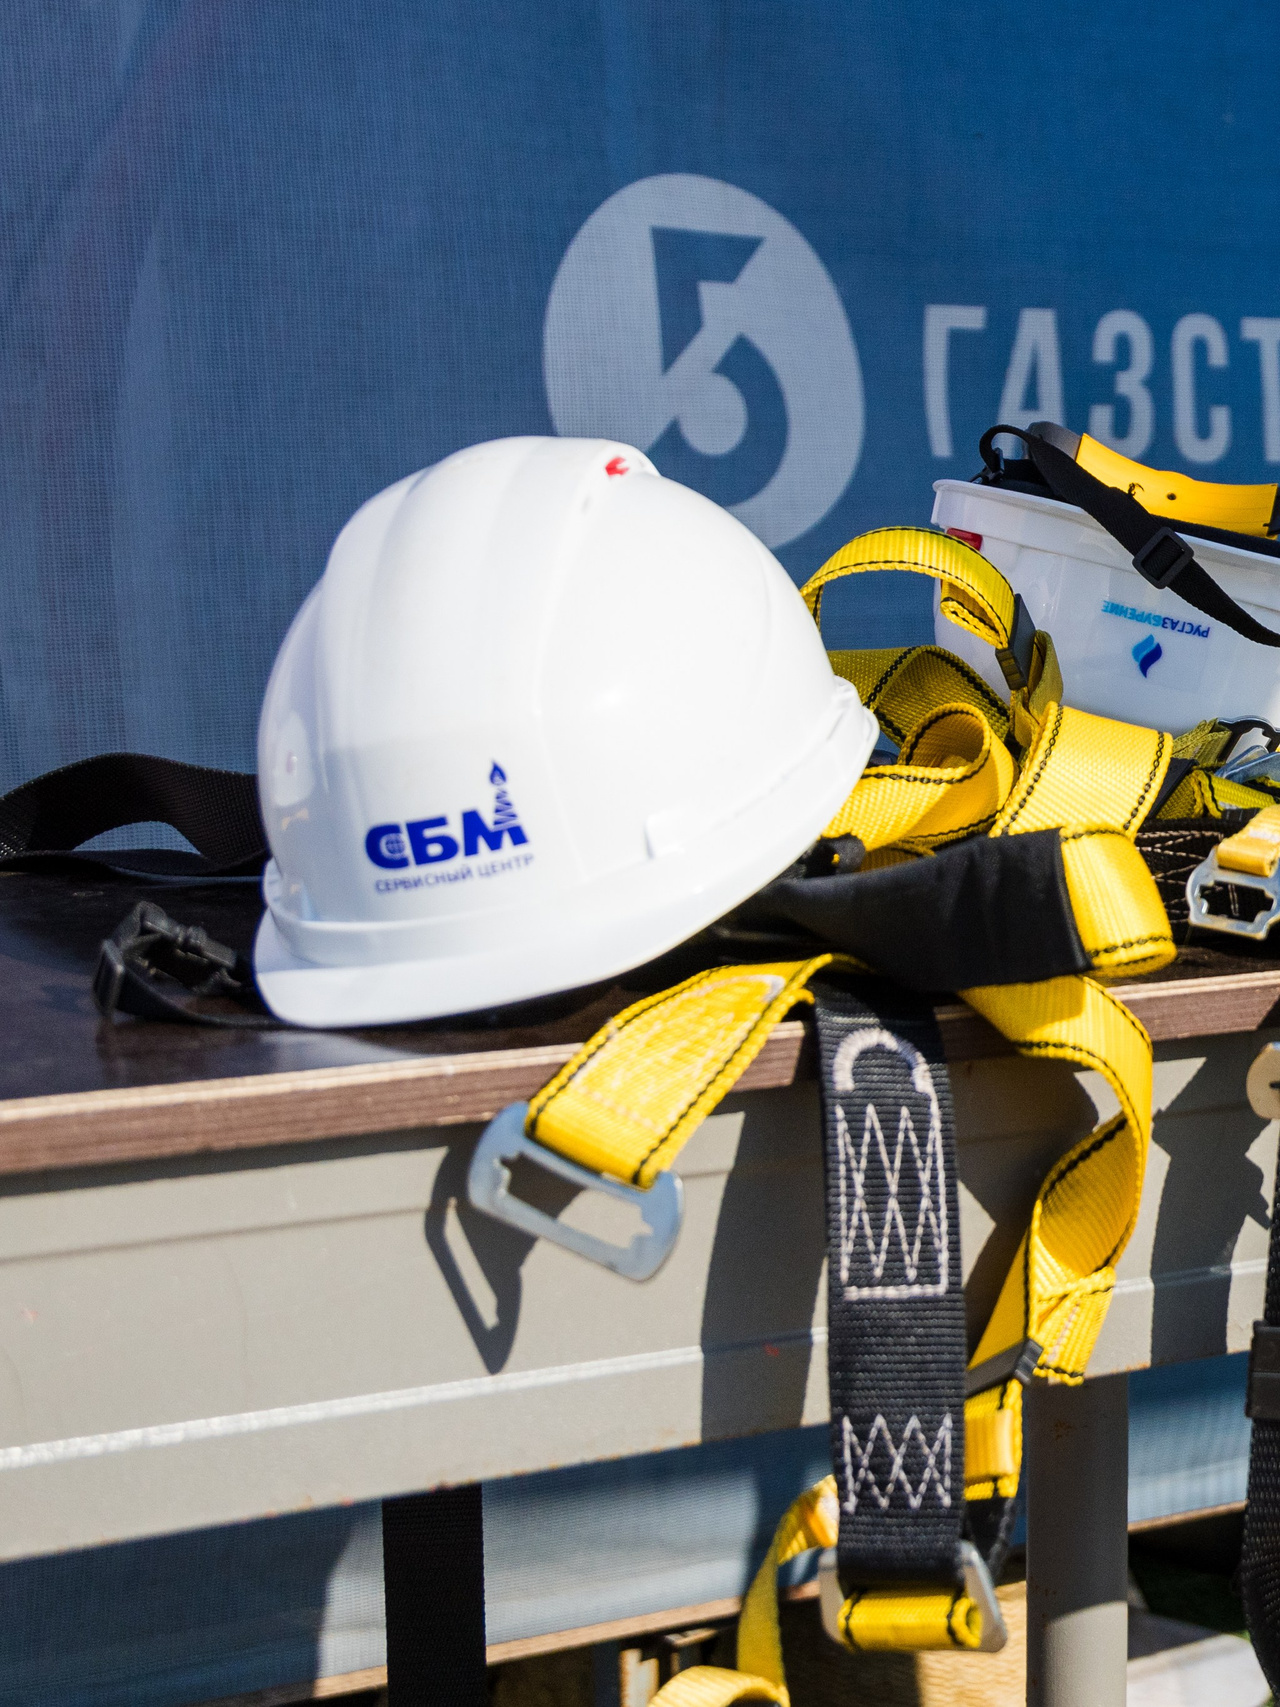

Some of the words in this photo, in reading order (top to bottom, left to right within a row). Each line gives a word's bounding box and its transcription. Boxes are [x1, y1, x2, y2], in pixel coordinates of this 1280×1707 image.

[1101, 600, 1211, 638] РУСГАЗБУРЕНИЕ
[364, 808, 529, 870] СБМ
[374, 864, 474, 894] СЕРВИСНЫЙ
[477, 852, 535, 877] ЦЕНТР
